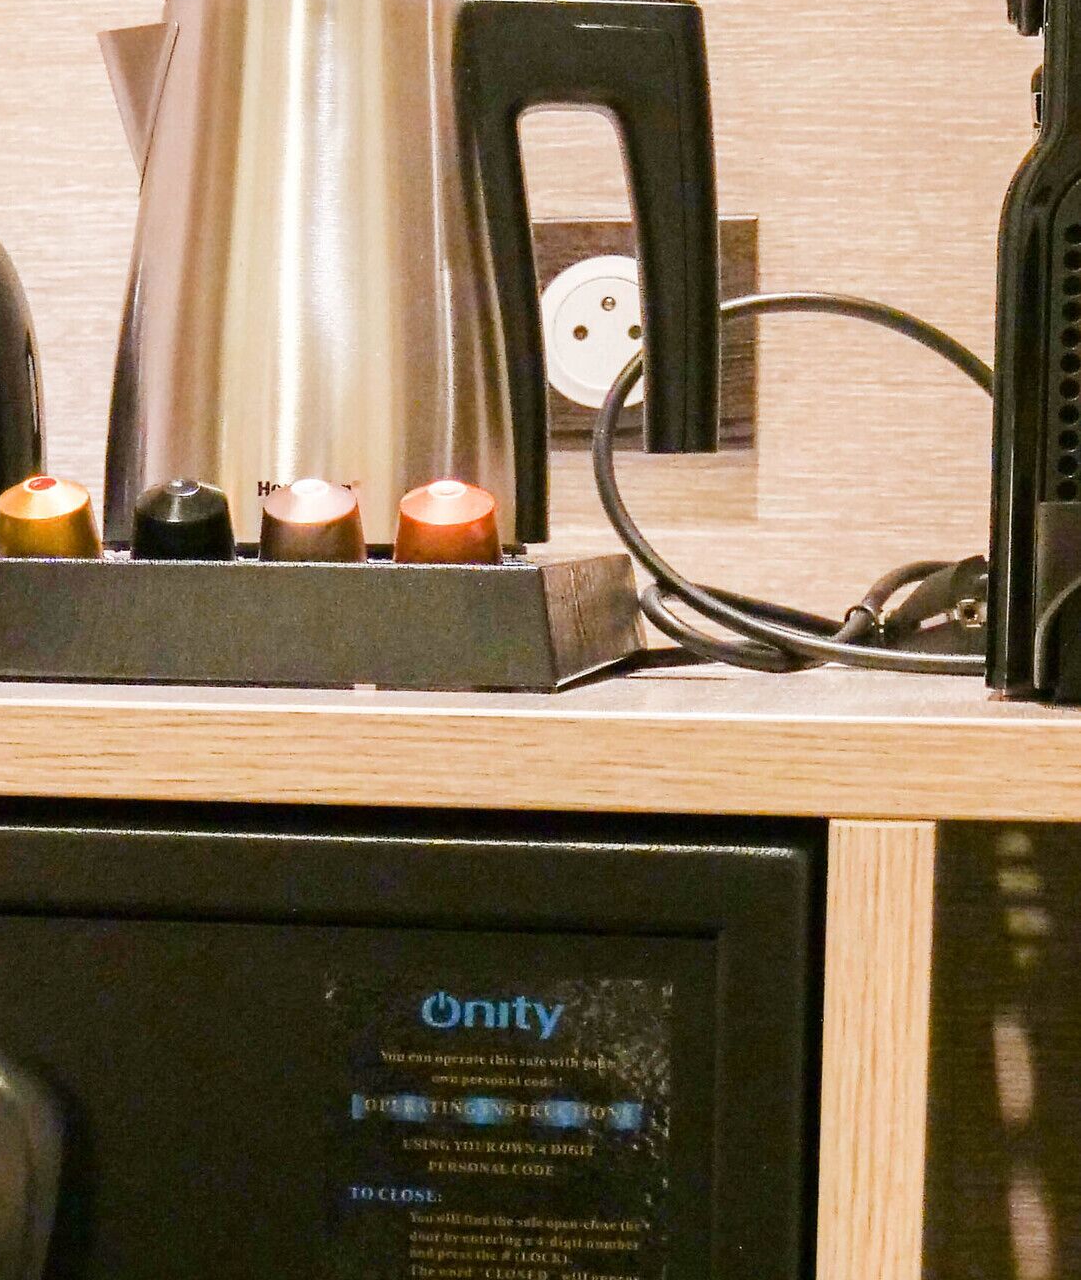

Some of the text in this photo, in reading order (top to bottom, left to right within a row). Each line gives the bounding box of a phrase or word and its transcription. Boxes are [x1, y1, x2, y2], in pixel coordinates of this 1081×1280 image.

[421, 990, 565, 1040] Onity
[408, 1054, 432, 1063] can
[434, 1054, 485, 1067] operate
[489, 1054, 517, 1066] this
[519, 1056, 547, 1067] safe
[549, 1057, 579, 1068] with
[461, 1076, 521, 1087] personal
[402, 1139, 450, 1151] USING
[454, 1141, 496, 1153] YOUR
[499, 1142, 536, 1154] OWN
[551, 1144, 595, 1156] DIGIT
[428, 1161, 554, 1176] PERSONAL CODE
[349, 1186, 442, 1203] TO CLOSE:
[409, 1211, 433, 1223] You
[436, 1213, 461, 1225] will
[492, 1217, 514, 1227] the
[516, 1218, 544, 1228] safe
[409, 1231, 440, 1243] door
[443, 1232, 459, 1245] by
[586, 1239, 639, 1251] number
[475, 1250, 497, 1261] the
[410, 1263, 435, 1276] The
